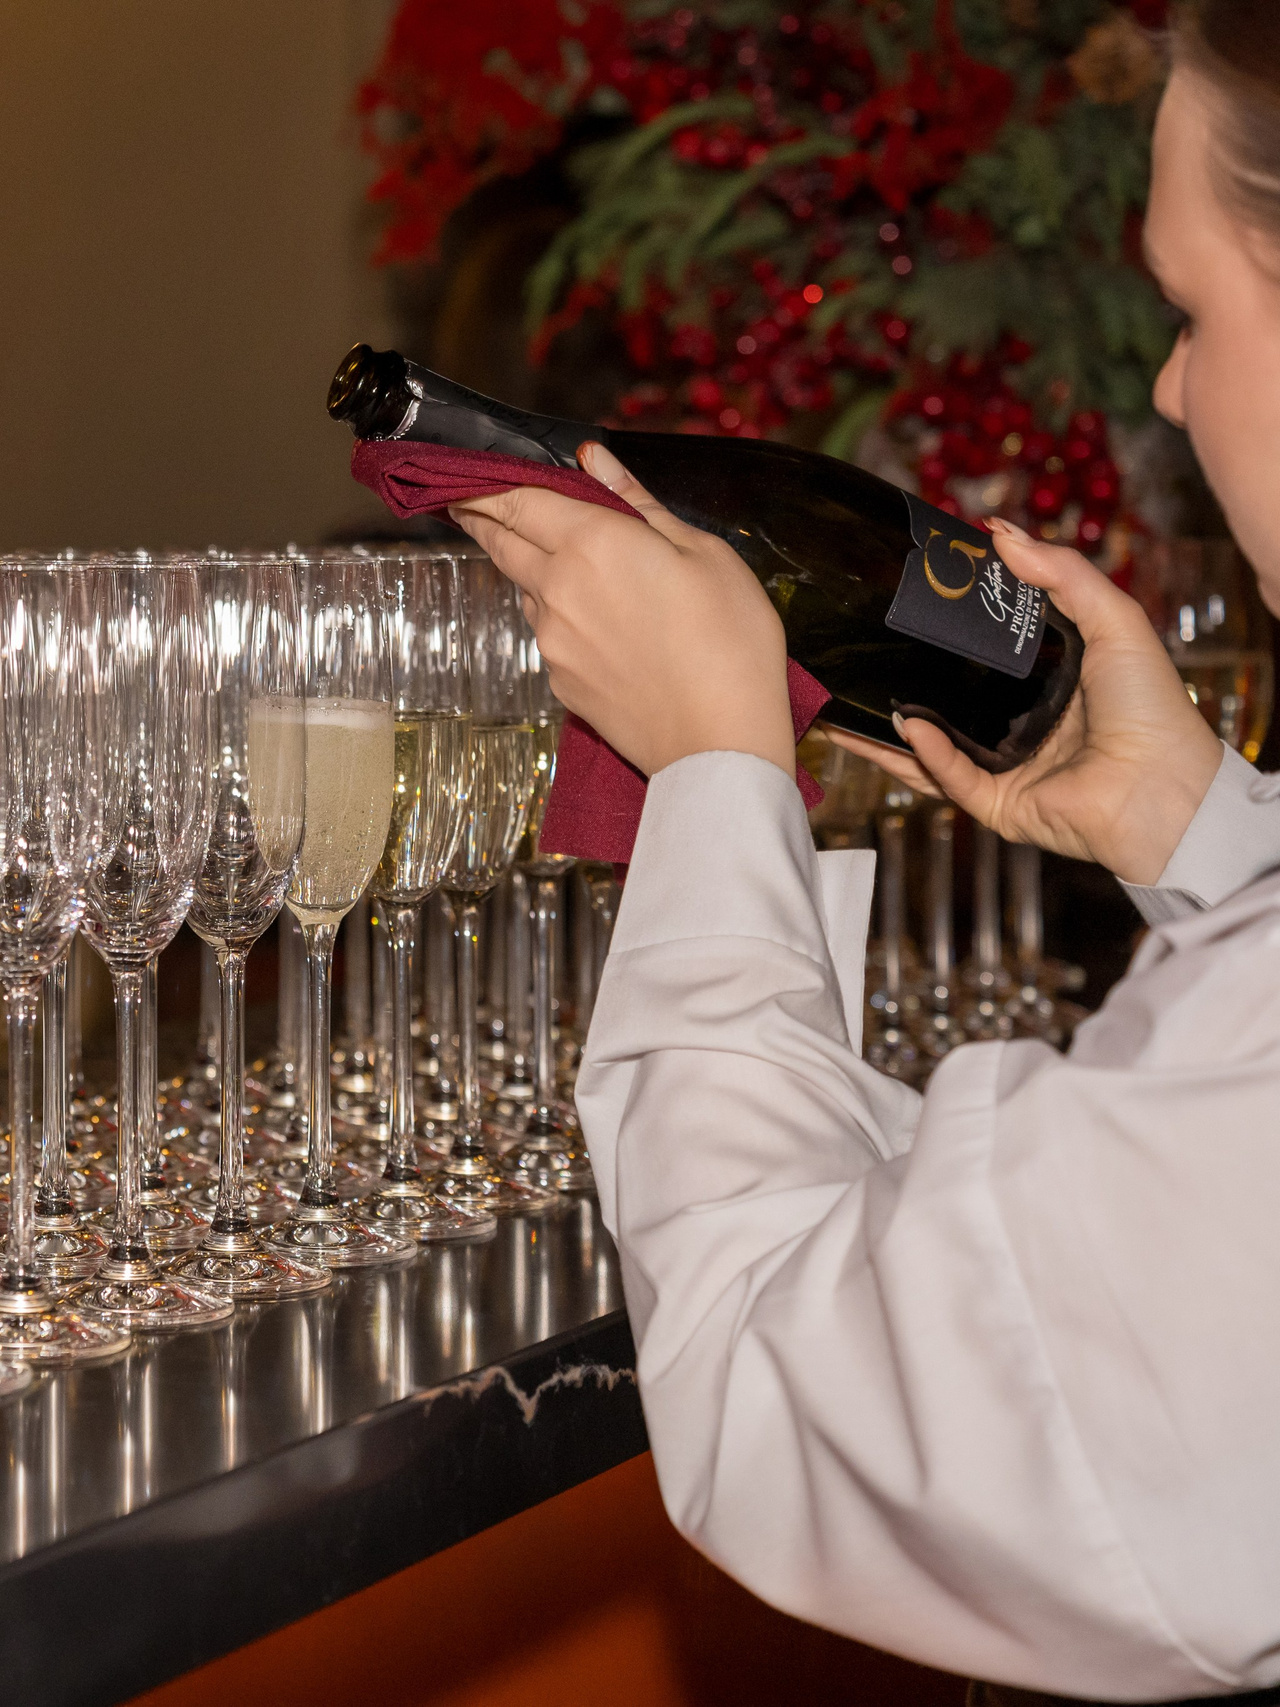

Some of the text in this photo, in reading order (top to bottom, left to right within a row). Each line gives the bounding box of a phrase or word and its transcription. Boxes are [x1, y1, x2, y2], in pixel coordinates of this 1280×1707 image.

[924, 527, 987, 600] G
[1014, 613, 1031, 655] DENOMINAZIONE
[1026, 589, 1034, 607] ORIGINE
[1027, 602, 1040, 639] EXTRA
